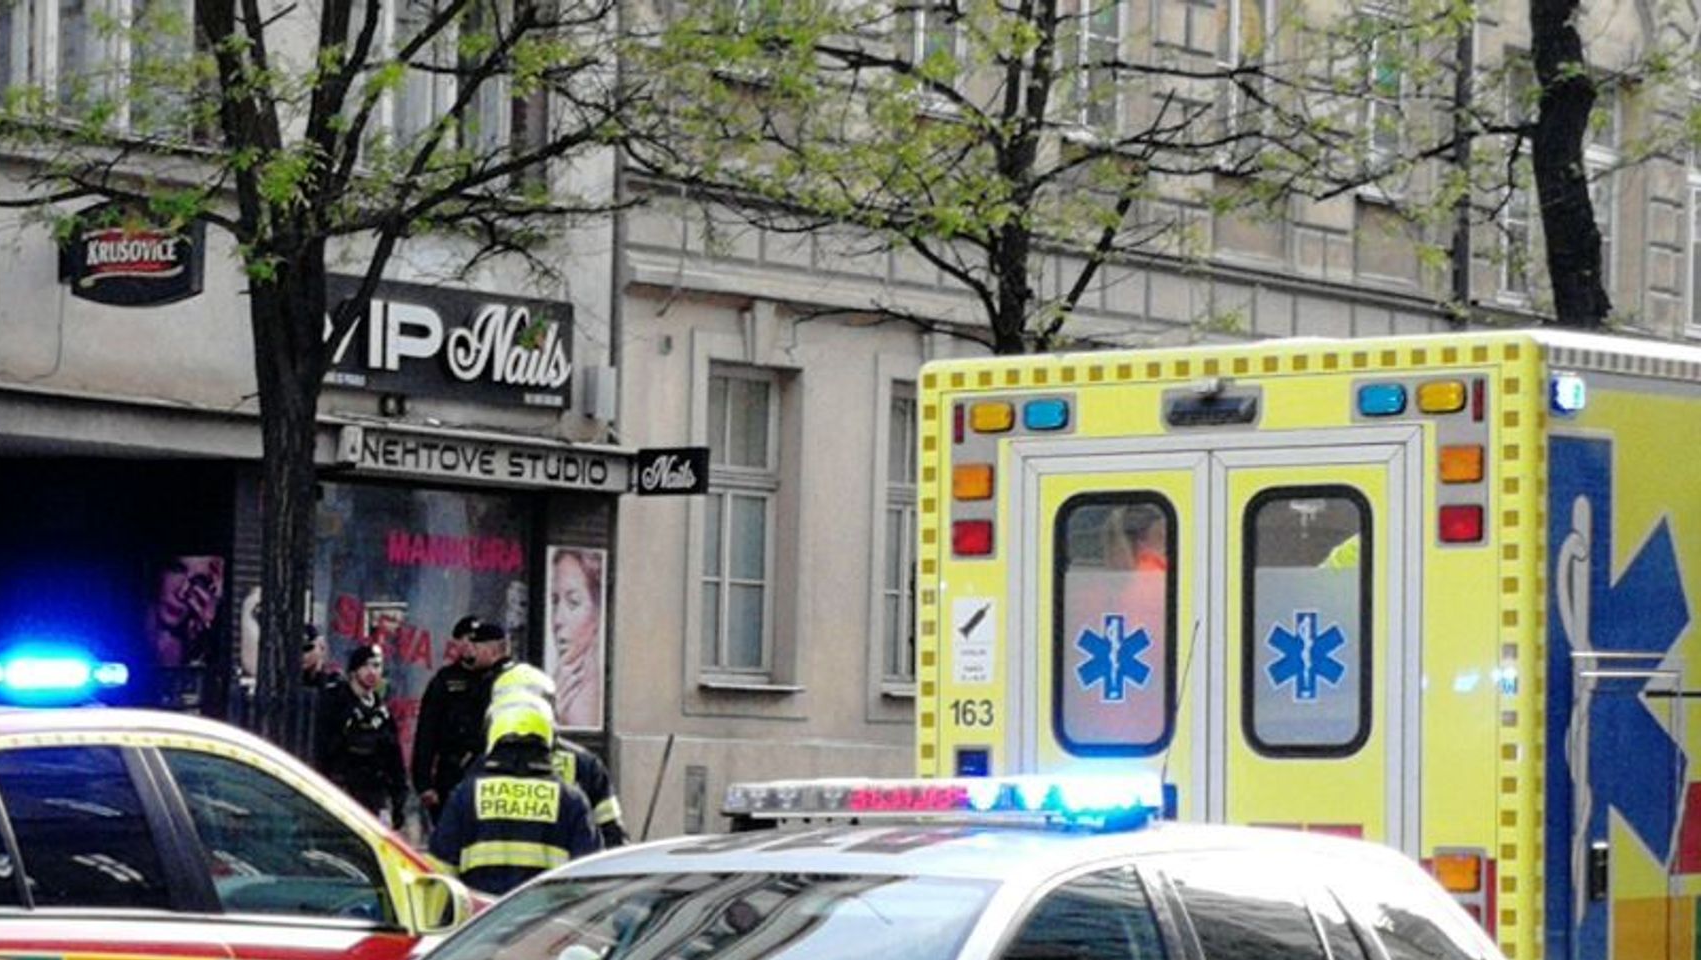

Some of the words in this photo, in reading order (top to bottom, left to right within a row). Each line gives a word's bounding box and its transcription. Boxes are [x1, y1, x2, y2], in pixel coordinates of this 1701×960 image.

[449, 304, 572, 388] Nails
[508, 453, 608, 484] STUDIO
[642, 455, 697, 490] Nails
[950, 699, 994, 727] 163
[480, 799, 554, 818] PRAHA
